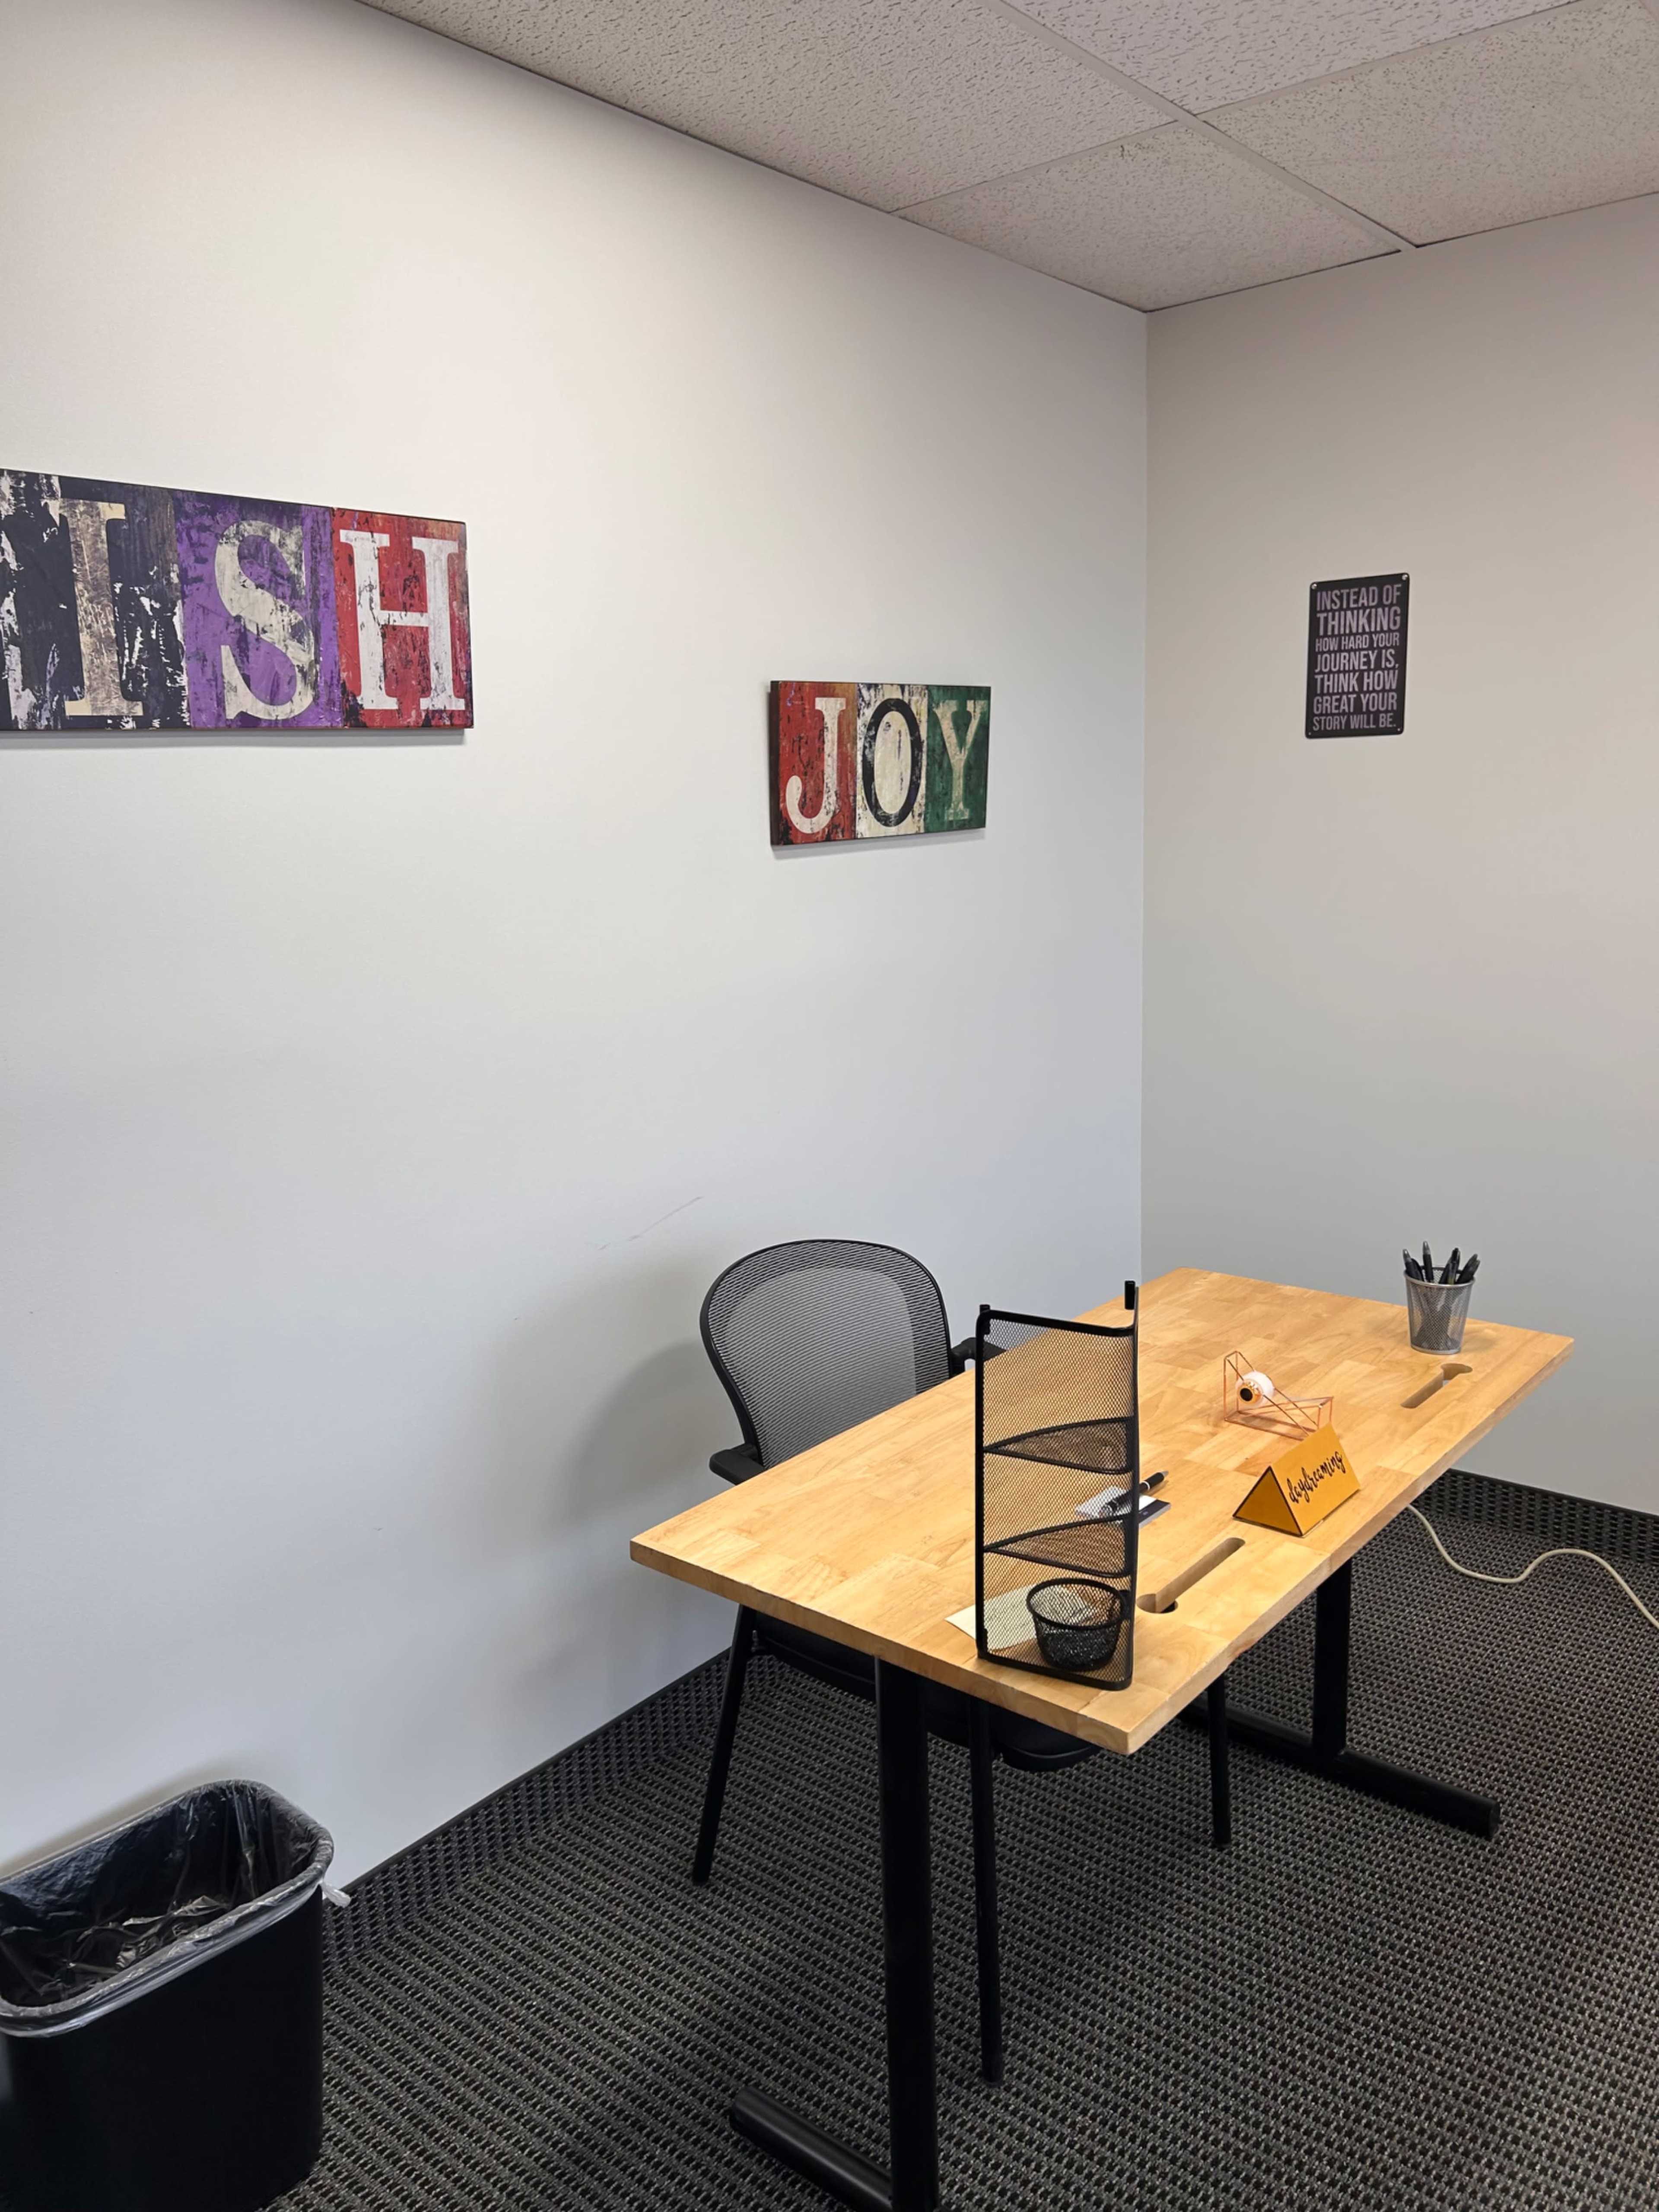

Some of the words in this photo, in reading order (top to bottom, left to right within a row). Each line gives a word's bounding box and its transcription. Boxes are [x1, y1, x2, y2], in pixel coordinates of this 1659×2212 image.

[41, 497, 465, 720] ISH
[1316, 587, 1378, 611] INSTEAD
[1382, 584, 1402, 605] OF
[1316, 606, 1401, 636] THINKING
[1315, 637, 1338, 652] HOW
[1341, 635, 1369, 650] HARD
[1372, 632, 1399, 647] YOUR
[1315, 650, 1378, 673] JOURNEY
[1382, 649, 1398, 669] IS,
[1314, 672, 1359, 694] THINK
[1363, 670, 1398, 691] HOW
[1313, 694, 1357, 714] GREAT
[1360, 692, 1397, 712] YOUR
[1313, 715, 1348, 731] STORY
[1350, 714, 1376, 729] WILL
[1379, 713, 1396, 728] BE.
[785, 697, 988, 834] JOY
[1287, 1451, 1346, 1503] daydreaming
